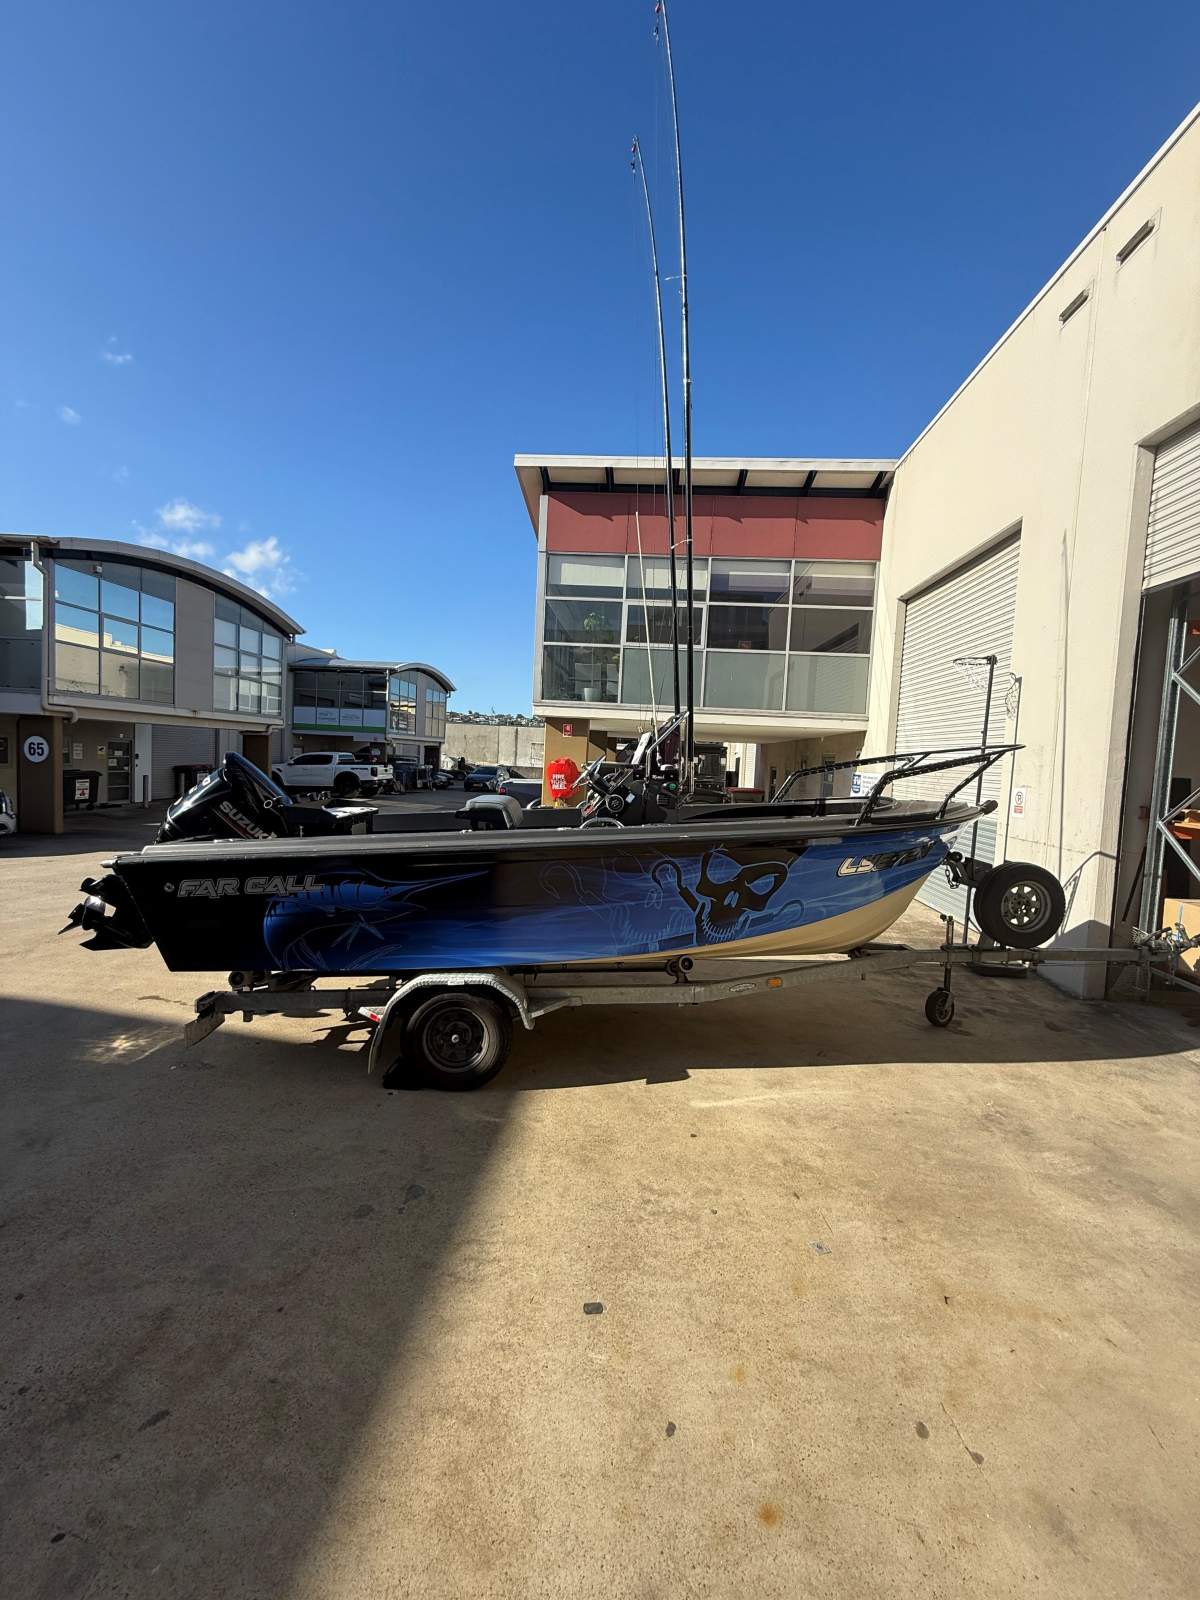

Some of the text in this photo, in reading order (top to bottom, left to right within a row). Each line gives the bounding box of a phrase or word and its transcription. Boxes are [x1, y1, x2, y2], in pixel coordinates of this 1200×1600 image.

[28, 742, 45, 756] 65
[177, 875, 324, 899] FAR CALL
